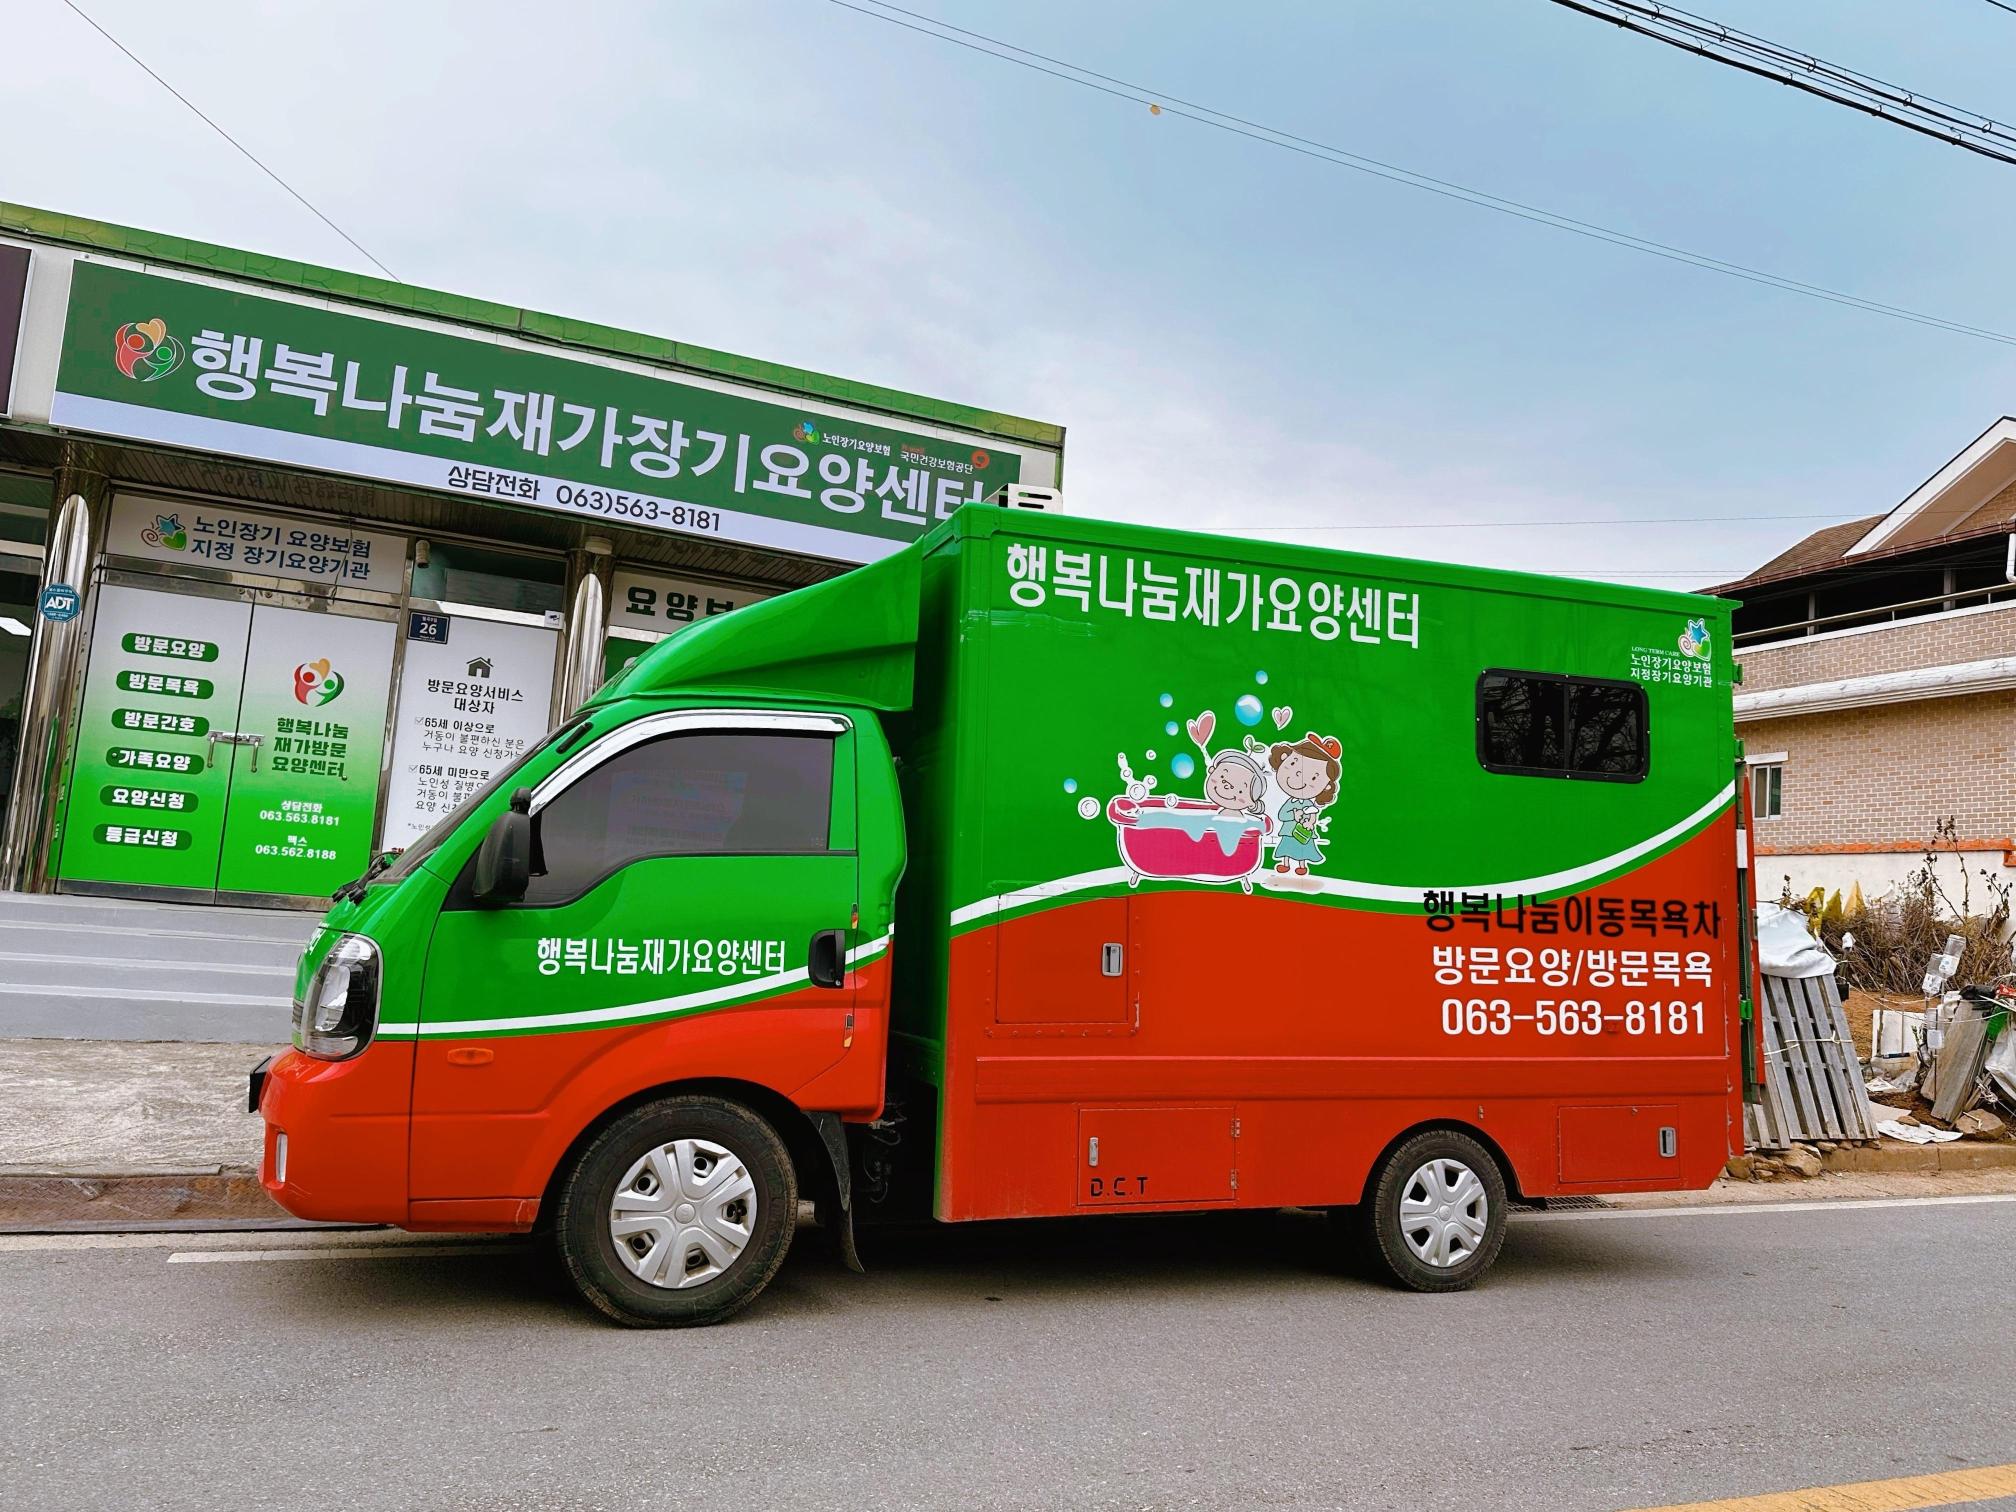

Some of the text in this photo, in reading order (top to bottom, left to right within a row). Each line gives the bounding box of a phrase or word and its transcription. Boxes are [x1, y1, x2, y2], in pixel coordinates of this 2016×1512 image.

[191, 329, 985, 526] 행복나눔재가장기요양센터
[822, 433, 891, 456] 노인장기요양보험
[900, 451, 974, 474] 국민건강보험공단
[448, 466, 720, 531] 상담전화 063)563-8181
[193, 516, 371, 559] 노인장기 요양보험
[191, 539, 371, 580] 지정 장기요양기관
[44, 596, 75, 611] ADT
[1006, 543, 1420, 649] 행복나눔재가요양센터
[419, 622, 438, 635] 26
[134, 635, 206, 658] 방문요양
[1630, 654, 1712, 675] 노인장기요양보험
[129, 673, 199, 696] 방문목욕
[1630, 667, 1712, 688] 지정장기요양기관
[427, 679, 524, 702] 방문요양서비스
[454, 697, 495, 714] 대상자
[124, 711, 196, 733] 방문간호
[277, 717, 349, 739] 행복나눔
[424, 717, 495, 734] 65세 이상으로
[274, 736, 347, 758] 재가방문
[423, 742, 454, 753] 누구나
[458, 745, 479, 757] 요양
[424, 730, 525, 750] 거동이 불편하신 분은
[118, 749, 191, 771] 가족요양
[272, 756, 345, 778] 요양센터
[418, 777, 449, 789] 노인성
[419, 765, 490, 780] 65세 미만으로
[112, 788, 185, 809] 요양신청
[416, 788, 448, 800] 거동이
[281, 800, 323, 814] 상담전화
[415, 800, 437, 812] 요양
[259, 810, 340, 826] 063.563.8181
[105, 826, 178, 847] 등급신청
[287, 835, 308, 847] 팩스
[255, 844, 337, 860] 063.562.8188
[1423, 890, 1722, 939] 행복나눔이동목욕차
[537, 936, 786, 976] 행복나눔재가요양센터
[1432, 945, 1713, 988] 방문요양/방문목욕
[1441, 999, 1705, 1036] 063-563-8181
